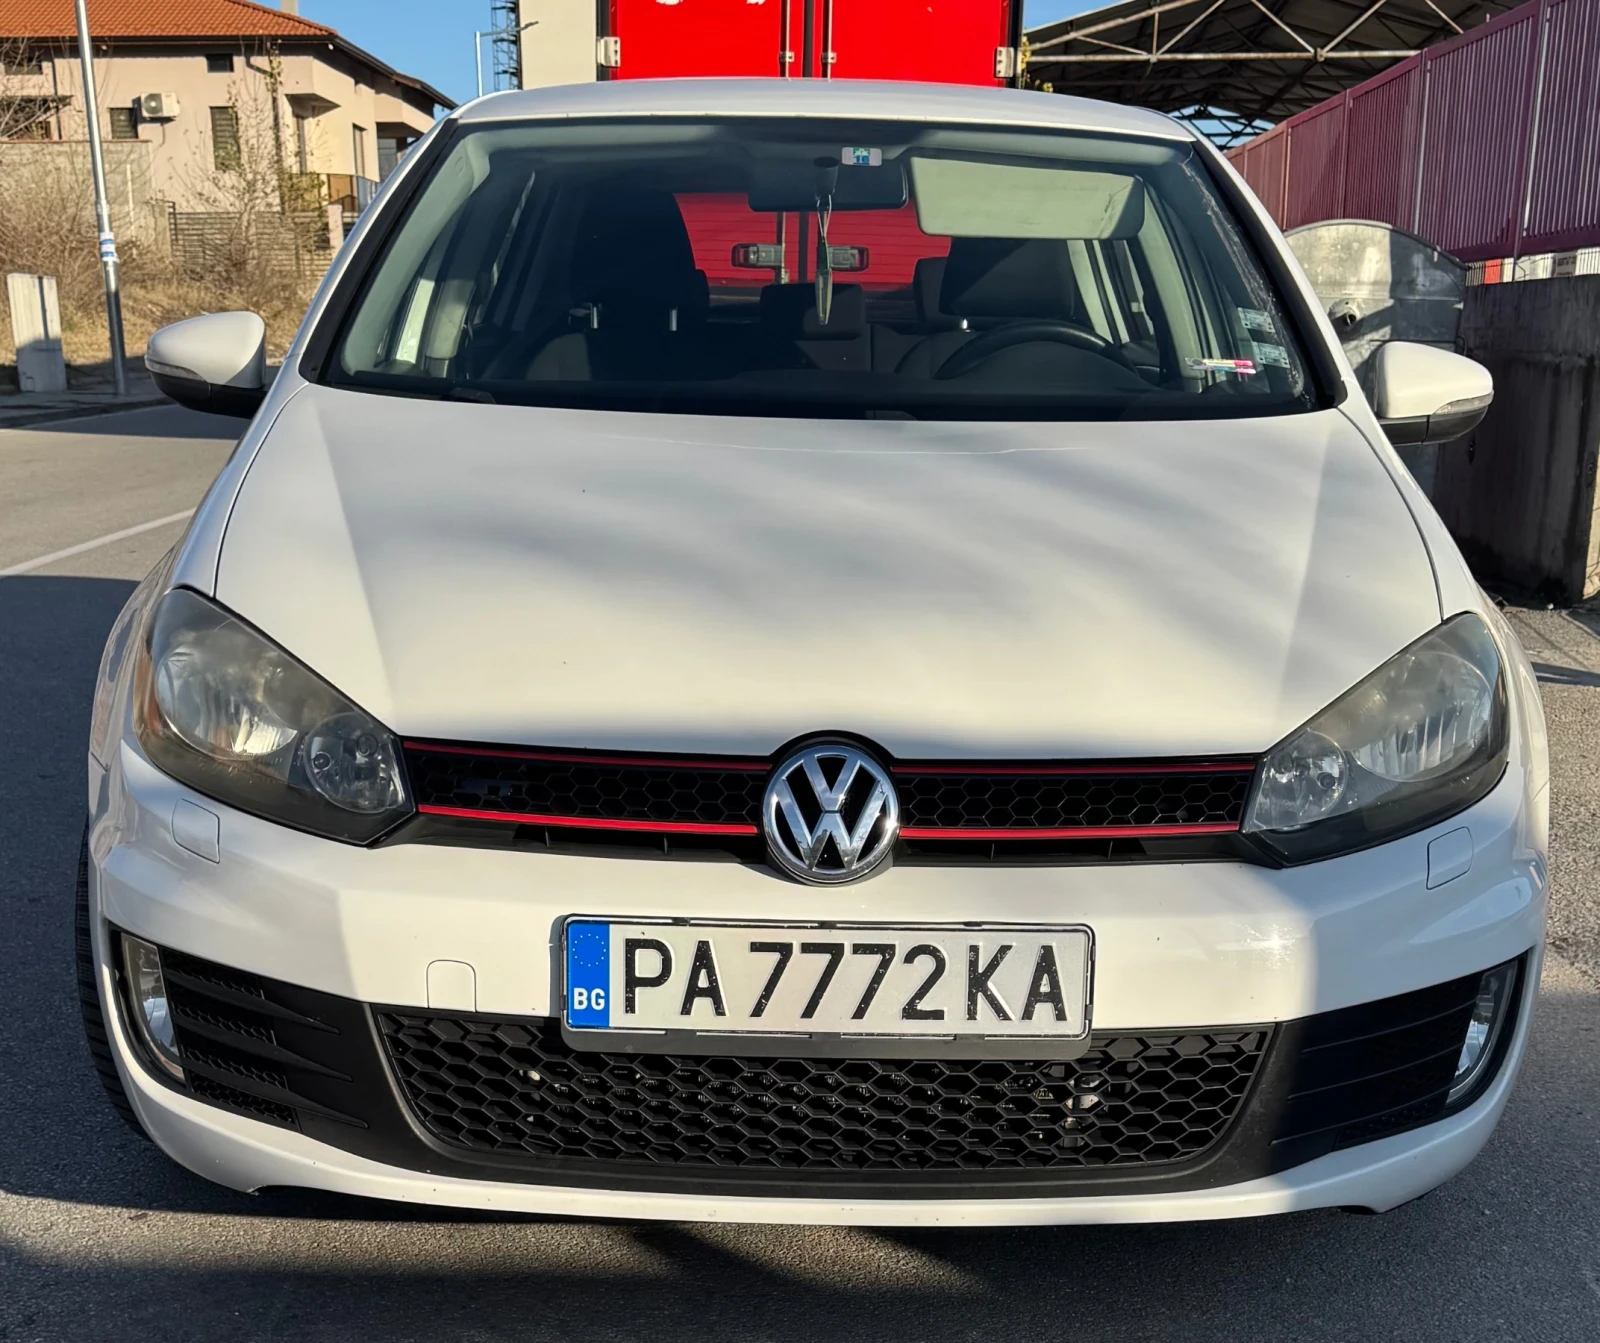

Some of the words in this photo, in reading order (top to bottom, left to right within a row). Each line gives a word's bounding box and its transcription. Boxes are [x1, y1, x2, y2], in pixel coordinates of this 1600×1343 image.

[768, 748, 892, 875] VW
[573, 987, 606, 1011] BG
[624, 937, 727, 1017] PA
[748, 941, 946, 1021] 7772
[966, 944, 1069, 1022] KA
